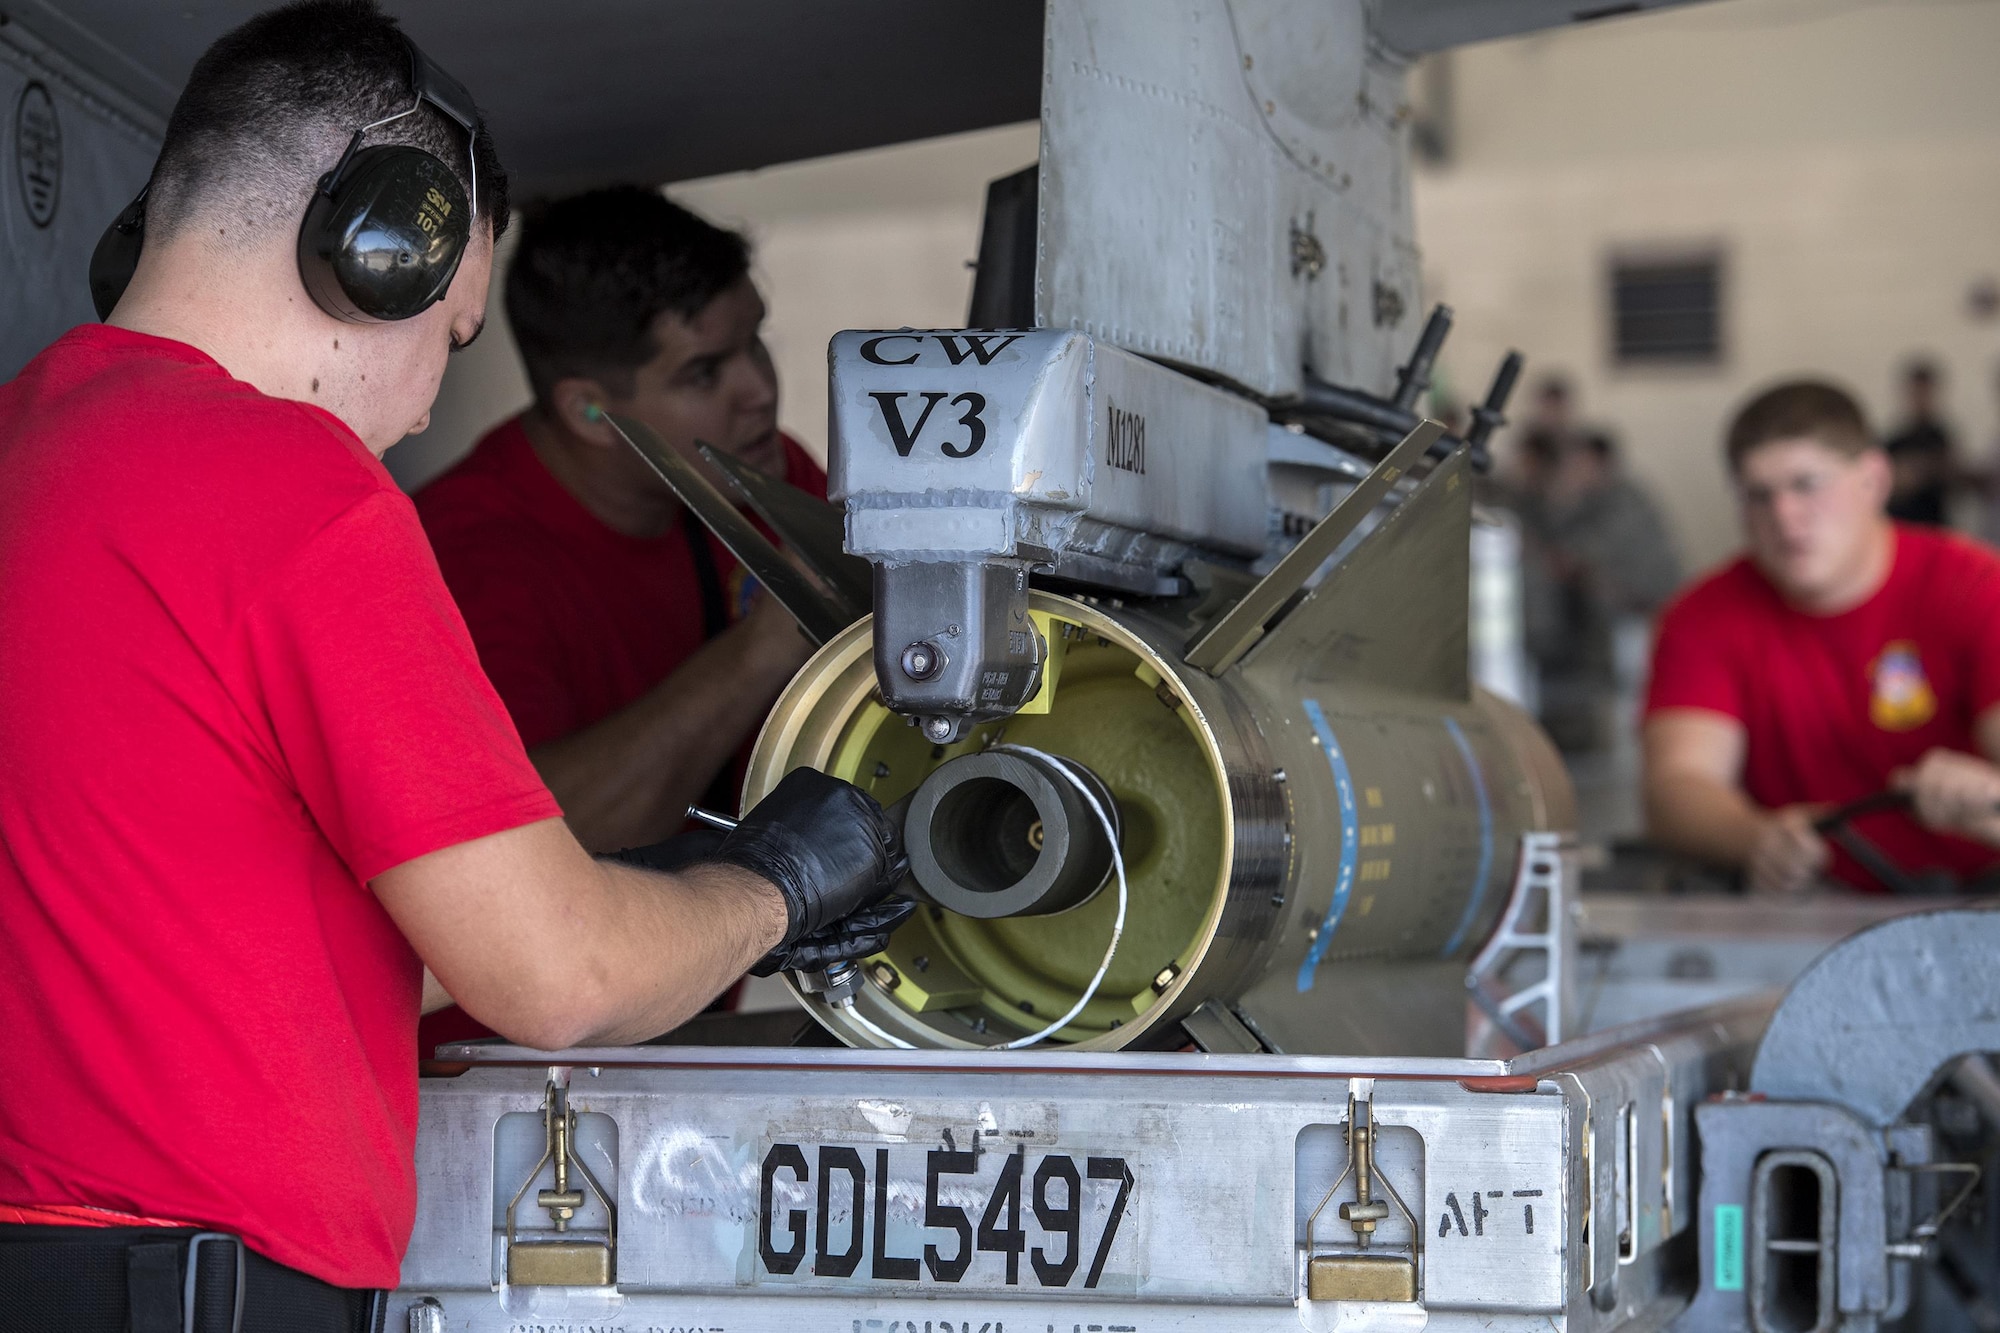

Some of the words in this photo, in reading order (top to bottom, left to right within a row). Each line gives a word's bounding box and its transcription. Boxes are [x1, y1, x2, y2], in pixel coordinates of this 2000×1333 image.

[417, 211, 438, 238] 101
[426, 187, 452, 217] 3M
[860, 335, 1026, 366] CW
[868, 391, 987, 458] V3
[1106, 406, 1146, 475] M1281
[758, 1143, 1136, 1289] GDL5497
[1438, 1189, 1543, 1238] AFT
